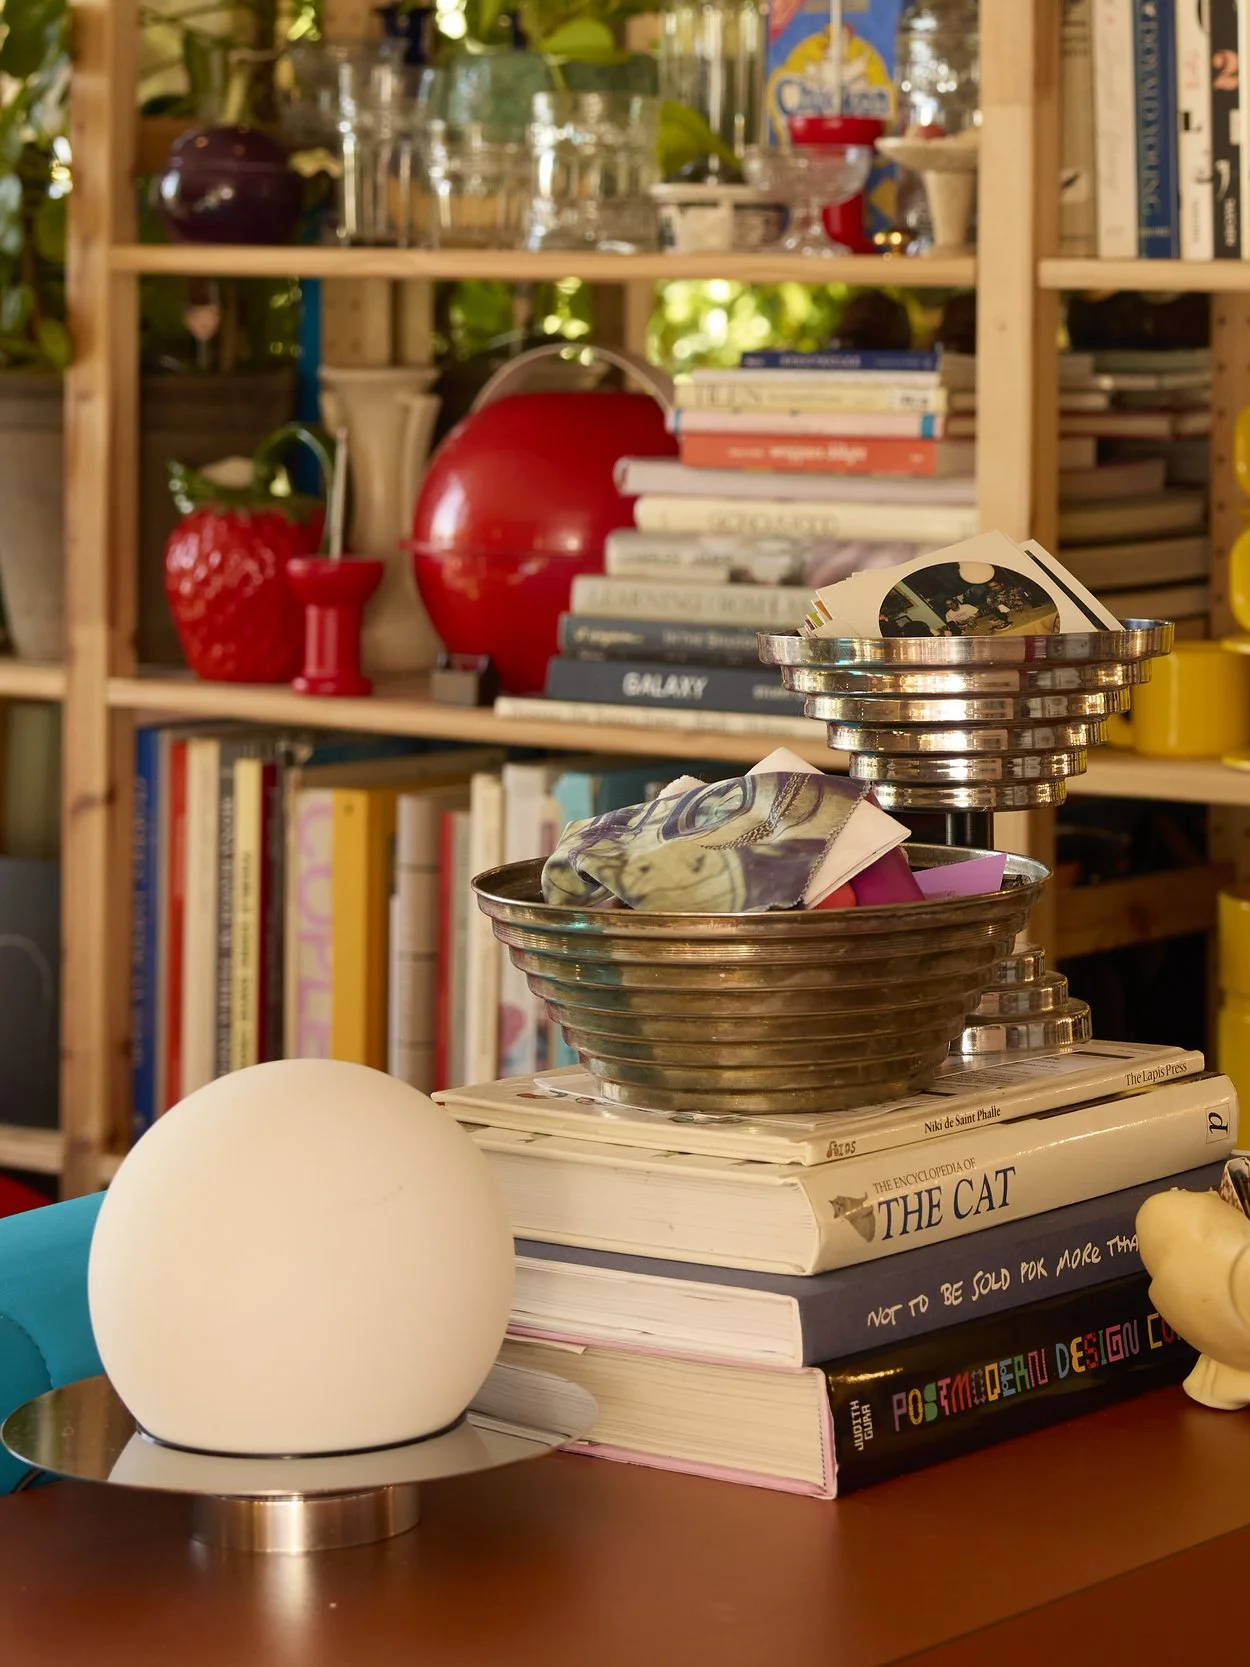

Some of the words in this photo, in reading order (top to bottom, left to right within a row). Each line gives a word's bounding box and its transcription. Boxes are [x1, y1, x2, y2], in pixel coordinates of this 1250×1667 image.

[622, 671, 709, 699] GALAXY
[1125, 1072, 1141, 1087] The
[1141, 1068, 1165, 1085] Lapis
[1165, 1062, 1188, 1078] Press
[924, 1120, 942, 1134] Niki
[944, 1117, 954, 1130] de
[955, 1113, 976, 1128] Saint
[976, 1106, 1001, 1123] Phalle
[873, 1179, 892, 1194] THE
[892, 1161, 963, 1191] ENCYCLOPEDIA
[963, 1157, 977, 1171] OF
[877, 1187, 943, 1241] THE
[953, 1166, 1016, 1220] CAT
[867, 1304, 903, 1328] NOT
[908, 1294, 929, 1317] TO
[940, 1280, 964, 1306] BE
[971, 1267, 1011, 1301] SOLD
[892, 1347, 1049, 1432] POSTMODERN
[1055, 1318, 1140, 1380] DESIGN
[850, 1399, 865, 1451] JUDITH
[863, 1403, 874, 1440] GURA
